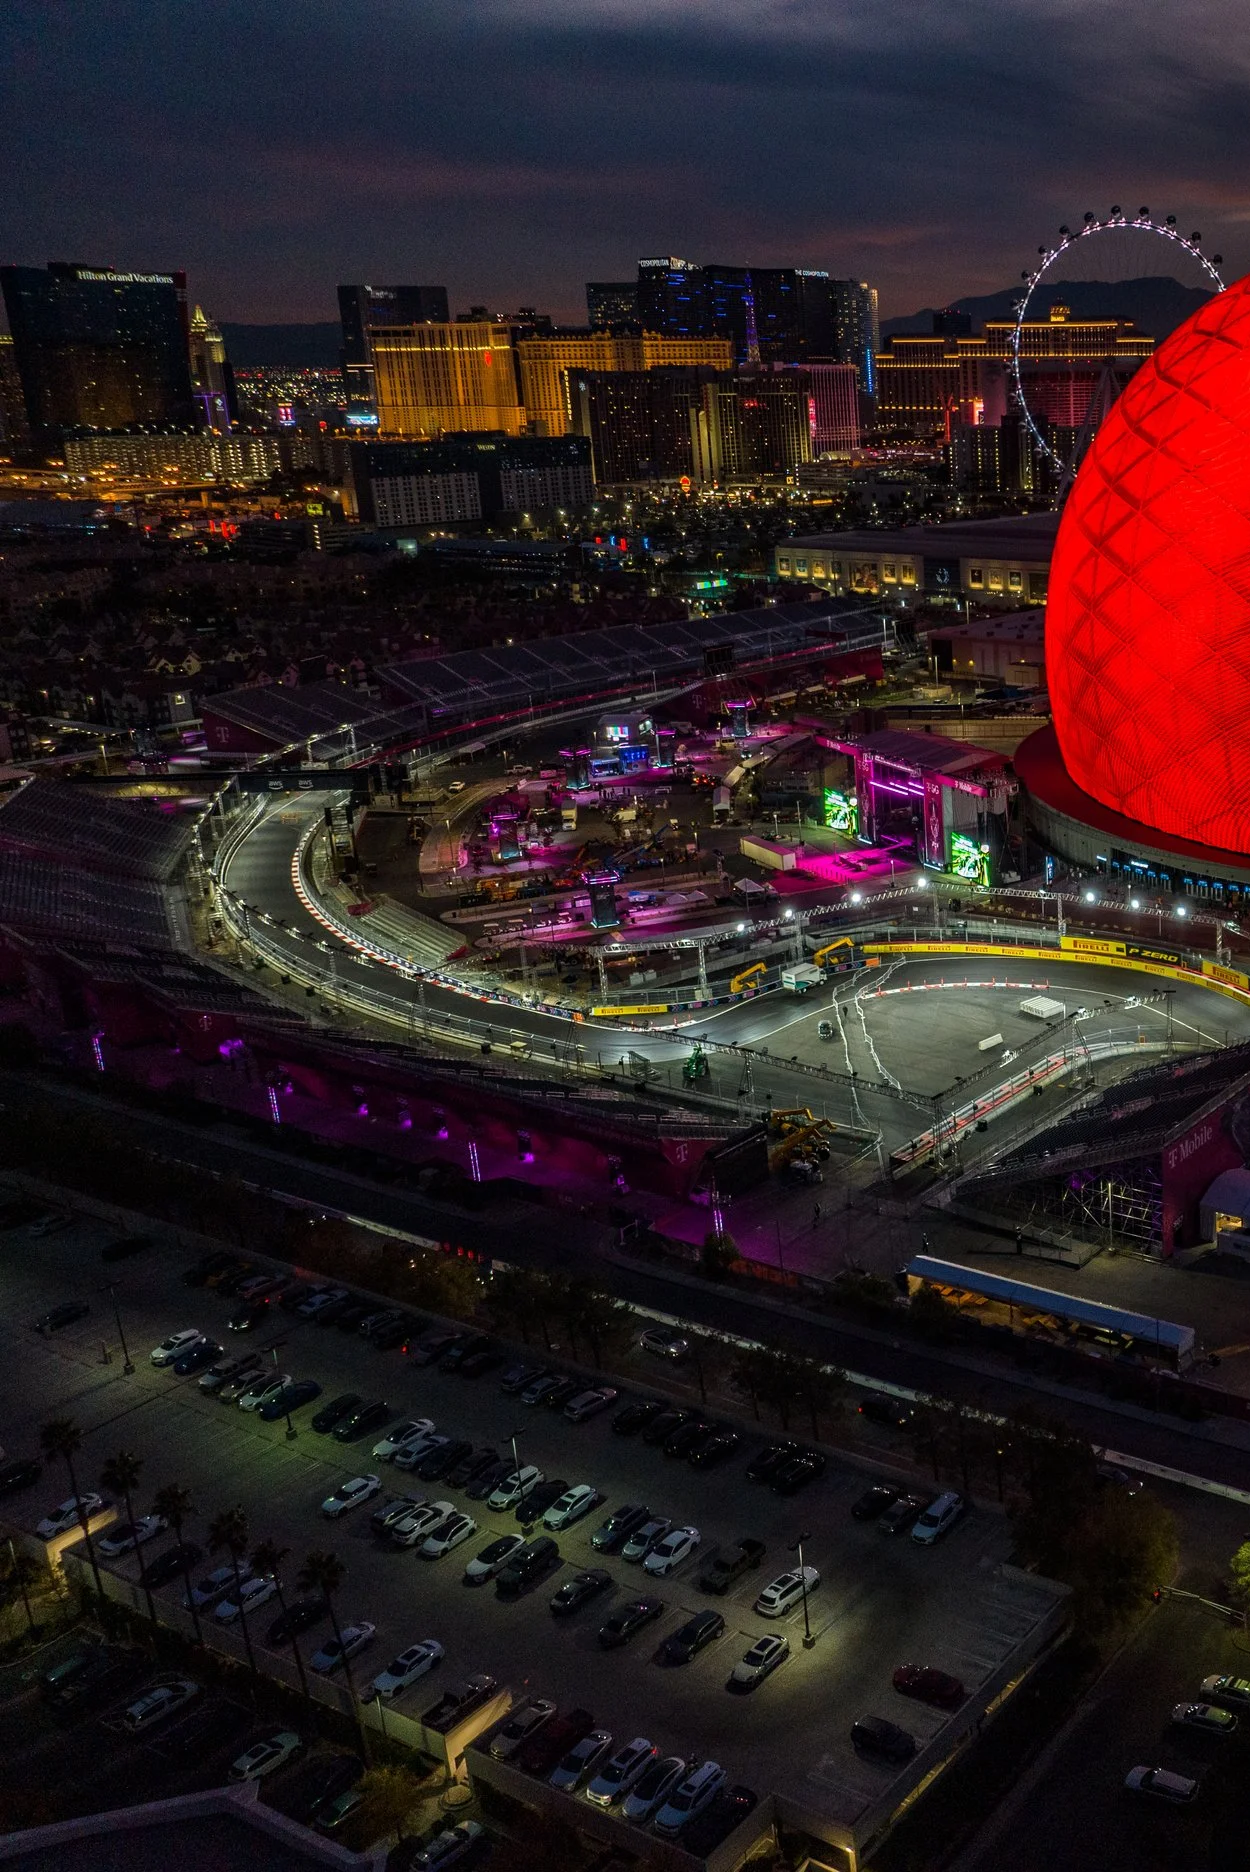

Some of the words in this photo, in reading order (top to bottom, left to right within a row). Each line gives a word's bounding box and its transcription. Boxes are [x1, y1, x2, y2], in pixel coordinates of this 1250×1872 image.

[78, 271, 107, 281] Hilton
[107, 272, 133, 282] Grand
[133, 273, 174, 284] Vacations
[1073, 940, 1110, 952] PIRELLI
[1141, 950, 1179, 963] ZERO
[1212, 965, 1241, 985] PIRELLI
